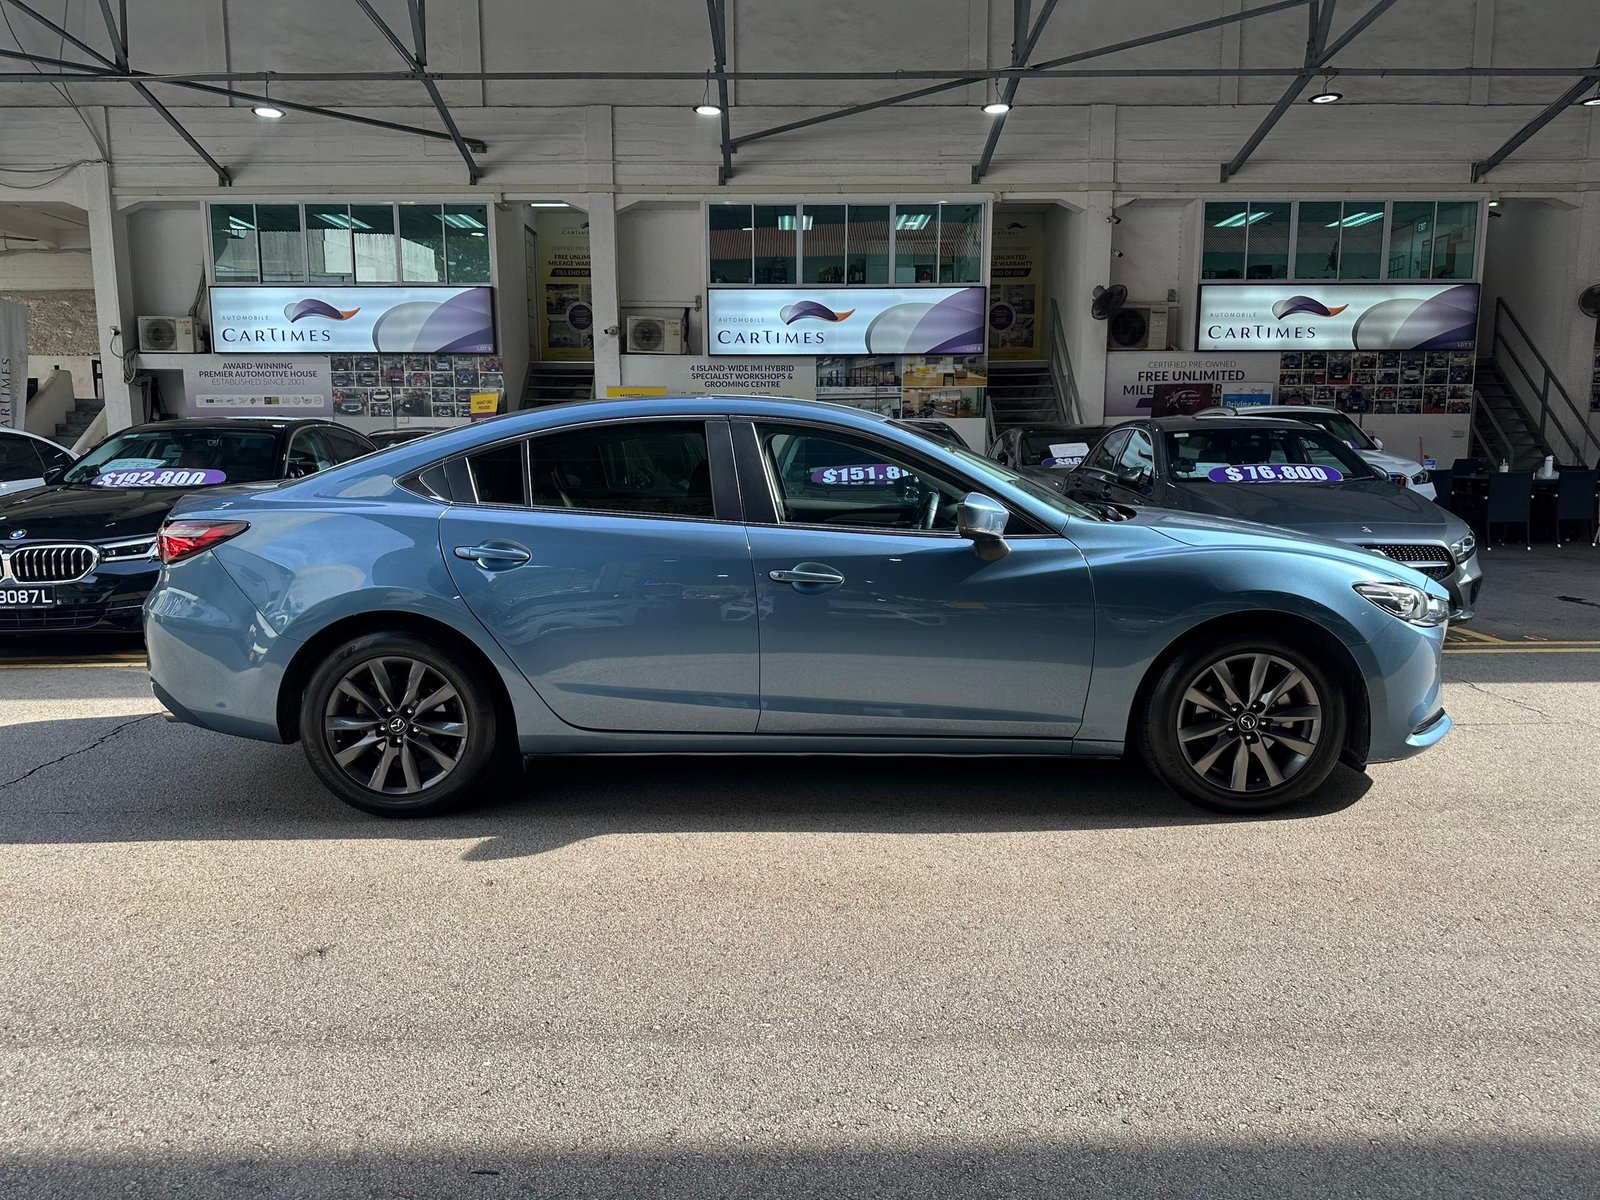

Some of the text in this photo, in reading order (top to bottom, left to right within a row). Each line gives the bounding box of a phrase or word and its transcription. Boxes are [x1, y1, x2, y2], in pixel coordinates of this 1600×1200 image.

[222, 362, 293, 370] AWARD-WINNING
[690, 364, 795, 372] 4 ISLAND-WIDE IMI HYBRID
[1148, 360, 1237, 369] CERTIFIED PRE-OWNED
[199, 370, 318, 378] PREMIER AUTOMOTIVE HOUSE
[691, 372, 793, 380] SPECIALIST WORKSHOPS &
[1138, 370, 1245, 382] FREE UNLIMITED
[211, 378, 306, 386] ESTABLISHED SINCE 2001
[704, 380, 781, 388] GROOMING CENTRE
[0, 357, 11, 429] ARTIMES
[1123, 384, 1155, 396] MILE
[822, 465, 904, 484] $151,8
[1224, 465, 1328, 481] $76,800
